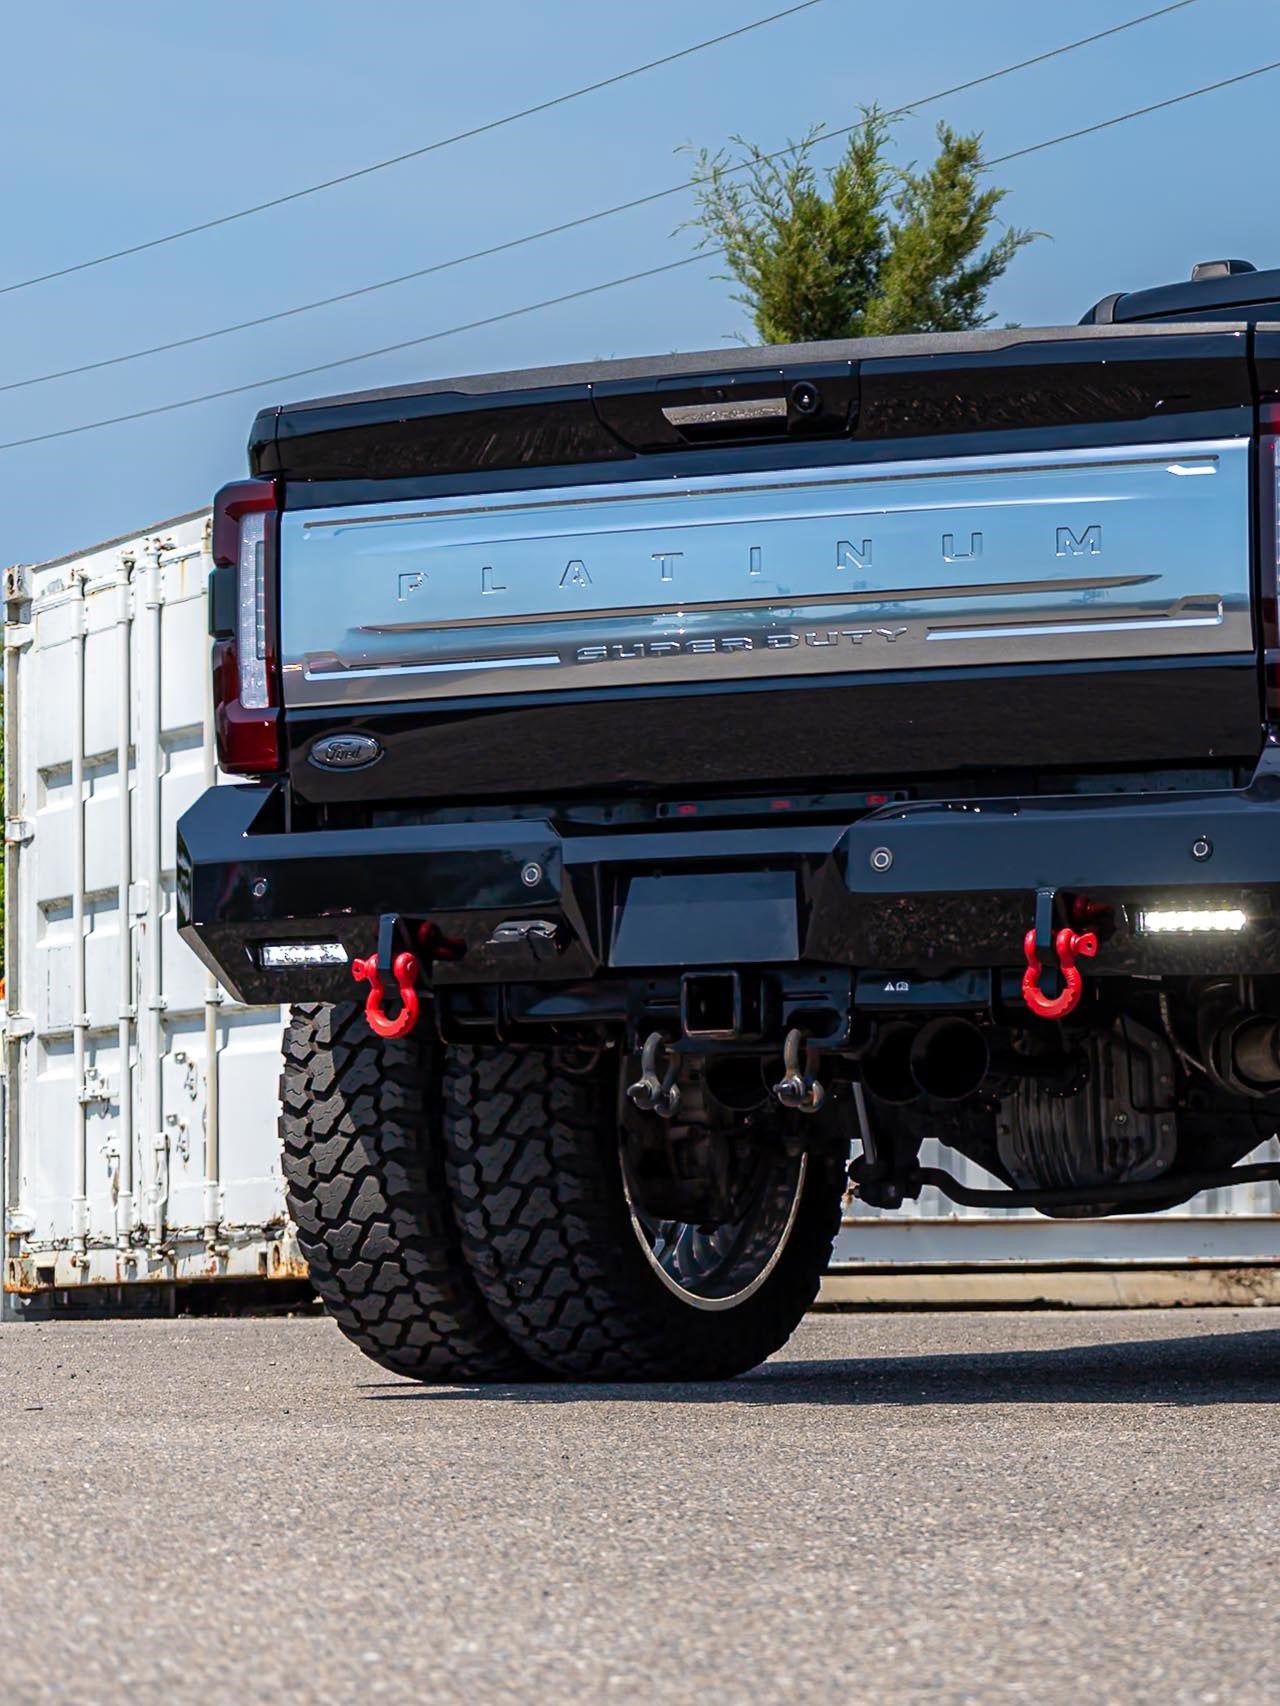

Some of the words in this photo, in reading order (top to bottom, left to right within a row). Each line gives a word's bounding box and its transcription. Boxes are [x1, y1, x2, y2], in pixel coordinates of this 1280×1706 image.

[398, 525, 1102, 601] PLATINUM
[577, 637, 753, 661] SUPER
[767, 626, 908, 650] DUTY
